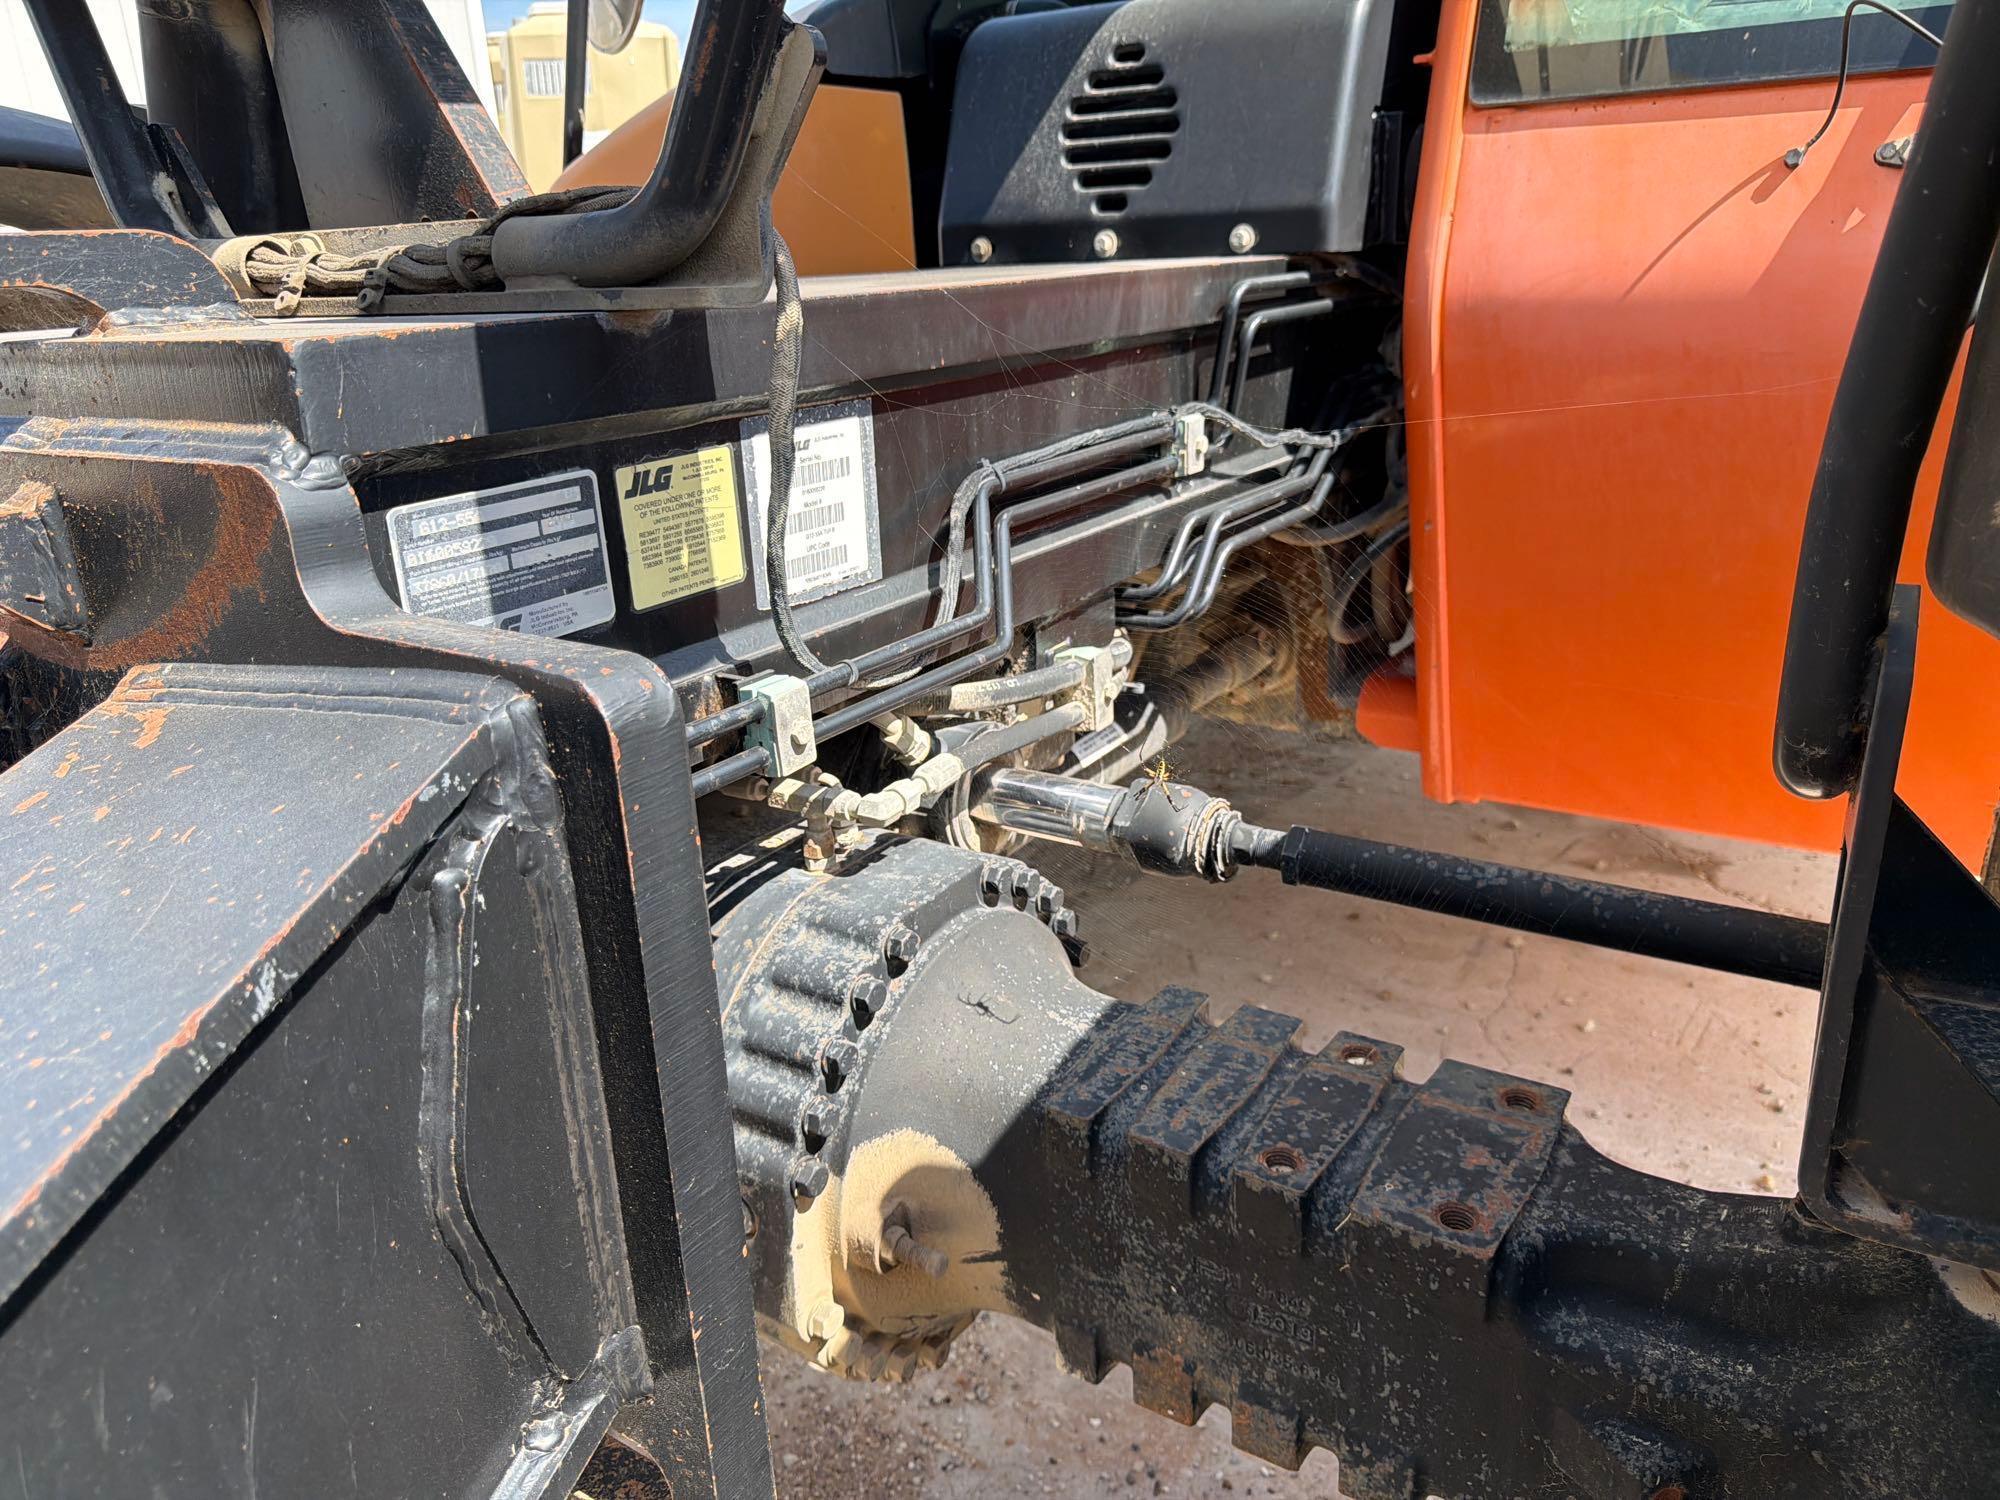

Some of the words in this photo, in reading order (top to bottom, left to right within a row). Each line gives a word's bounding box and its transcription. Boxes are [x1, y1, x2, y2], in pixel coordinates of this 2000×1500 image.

[800, 455, 813, 464] Serial
[624, 465, 673, 500] JLG
[634, 500, 661, 511] COVERED
[663, 495, 683, 504] UNDER
[684, 491, 696, 499] ONE
[706, 485, 721, 494] MORE
[662, 501, 694, 514] FOLLOWING
[696, 495, 718, 505] PATENTS
[653, 517, 670, 525] UNITED
[672, 512, 688, 520] STATES
[690, 507, 709, 516] PATENTS
[818, 541, 830, 549] Code
[689, 558, 707, 567] PATENTS
[662, 589, 677, 598] OTHER
[679, 583, 698, 593] PATENTS
[699, 577, 719, 586] PENDING
